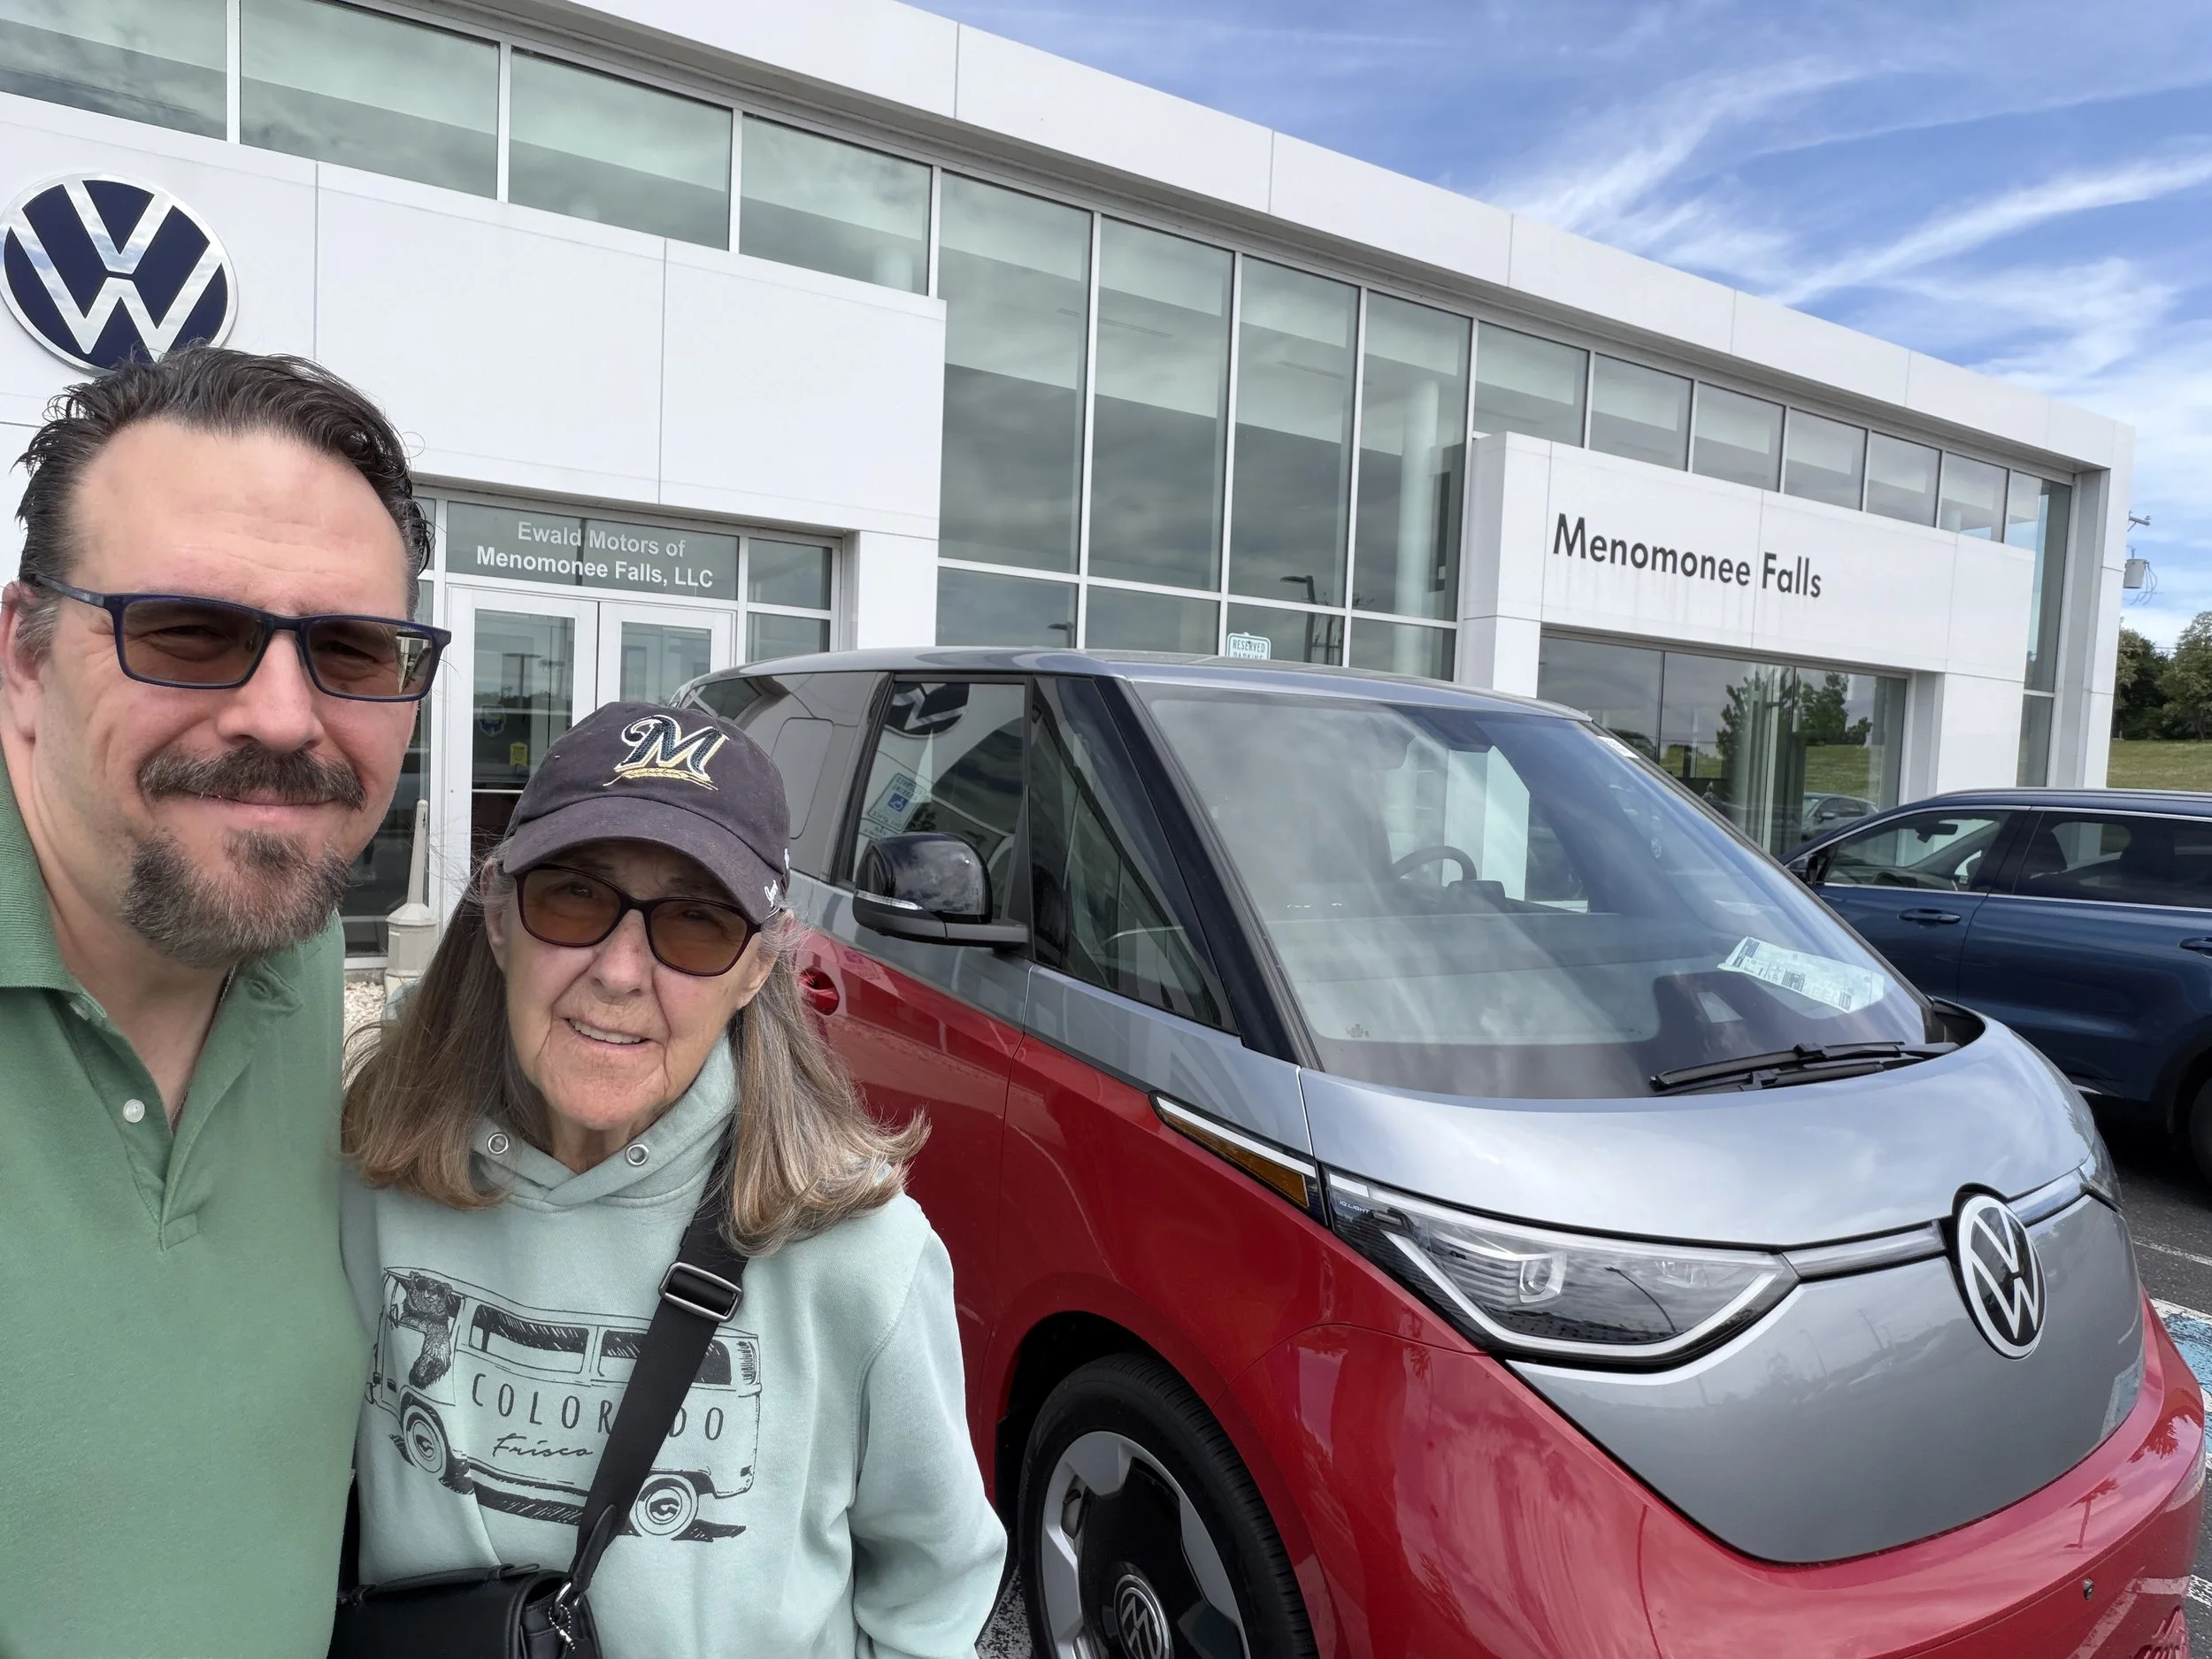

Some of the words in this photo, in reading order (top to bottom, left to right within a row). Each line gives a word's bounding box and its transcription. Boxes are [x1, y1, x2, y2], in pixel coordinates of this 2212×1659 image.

[518, 520, 581, 547] Ewald
[588, 529, 659, 556] Motors
[665, 539, 686, 558] of
[1553, 512, 1751, 586] Menomonee
[1762, 551, 1822, 598] Falls
[477, 545, 609, 579] Menomonee
[615, 561, 667, 588] Falls,
[674, 567, 714, 588] LLC
[1233, 639, 1265, 653] RESERVED
[613, 714, 729, 783] M
[472, 1372, 724, 1440] COLORDO
[492, 1432, 594, 1457] Frisco
